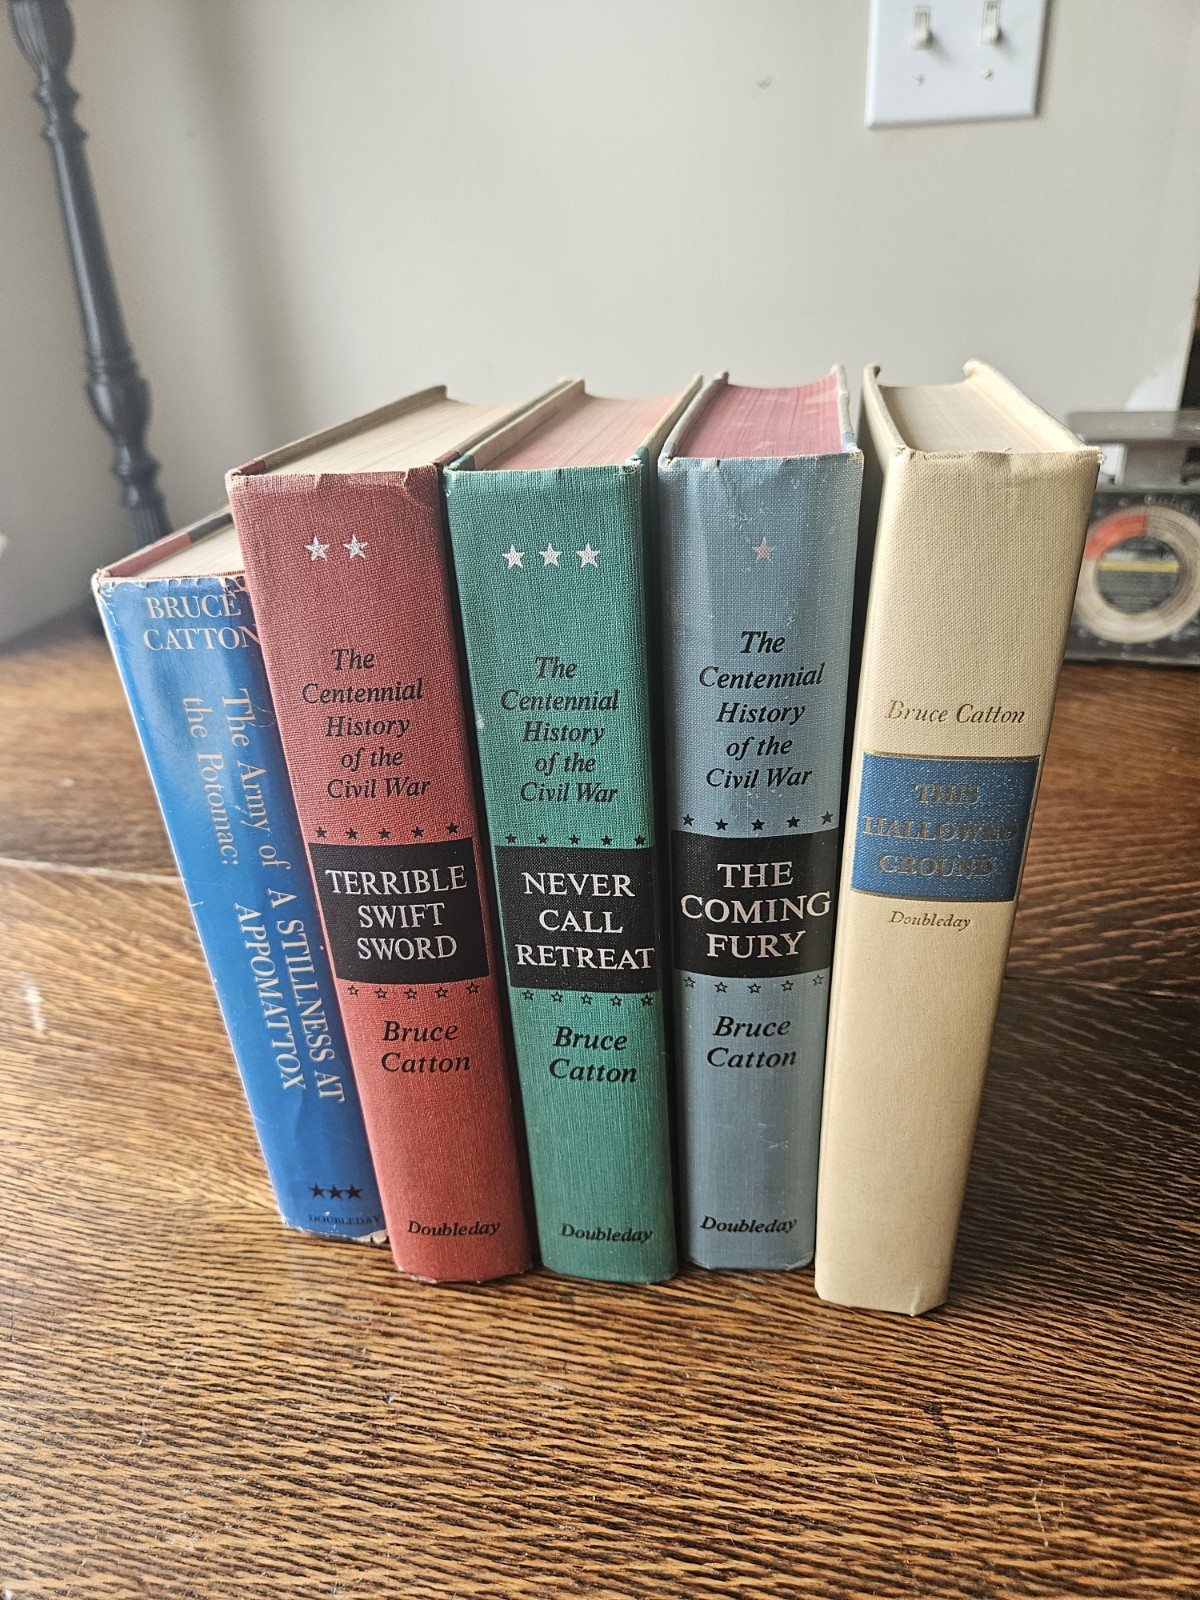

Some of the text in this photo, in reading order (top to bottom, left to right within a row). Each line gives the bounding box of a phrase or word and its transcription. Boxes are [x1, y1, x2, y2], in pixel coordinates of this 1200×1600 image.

[145, 594, 241, 619] BRUCE
[740, 630, 786, 654] The
[332, 649, 375, 670] The
[535, 656, 577, 679] The
[699, 662, 826, 689] Centennial
[302, 678, 423, 703] Centennial
[501, 688, 620, 711] Centennial
[716, 702, 806, 725] History
[885, 700, 1026, 724] Bruce Catton
[326, 716, 410, 738] History
[523, 721, 606, 746] History
[341, 747, 403, 772] of the
[726, 736, 793, 761] of the
[534, 752, 597, 776] of the
[182, 697, 239, 865] the Potomac:
[221, 688, 291, 869] The Army of
[327, 776, 431, 799] Civil War
[706, 766, 813, 789] Civil War
[520, 782, 619, 803] Civil War
[914, 783, 981, 805] THIS
[863, 815, 1020, 843] HALLOWED
[717, 861, 794, 888] THE
[878, 854, 994, 878] GROUND
[325, 865, 468, 895] TERRIBLE
[521, 872, 635, 897] NEVER
[358, 902, 445, 929] SWIFT
[680, 891, 832, 924] COMING
[539, 909, 624, 934] CALL
[888, 910, 972, 932] Doubleday
[356, 935, 458, 961] SWORD
[515, 943, 656, 970] RETREAT
[706, 930, 806, 959] FURY
[234, 902, 306, 1090] APPOMATTOX
[268, 888, 345, 1103] A STILLNESS AT
[383, 1020, 459, 1042] Bruce
[552, 1025, 628, 1051] Bruce
[712, 1015, 791, 1038] Bruce
[381, 1052, 471, 1074] Catton
[707, 1046, 797, 1069] Catton
[549, 1058, 637, 1083] Catton
[308, 1213, 381, 1226] DOUBLEDAY
[407, 1220, 500, 1237] Doubleday
[700, 1215, 797, 1235] Doubleday
[560, 1222, 653, 1244] Doubleday
